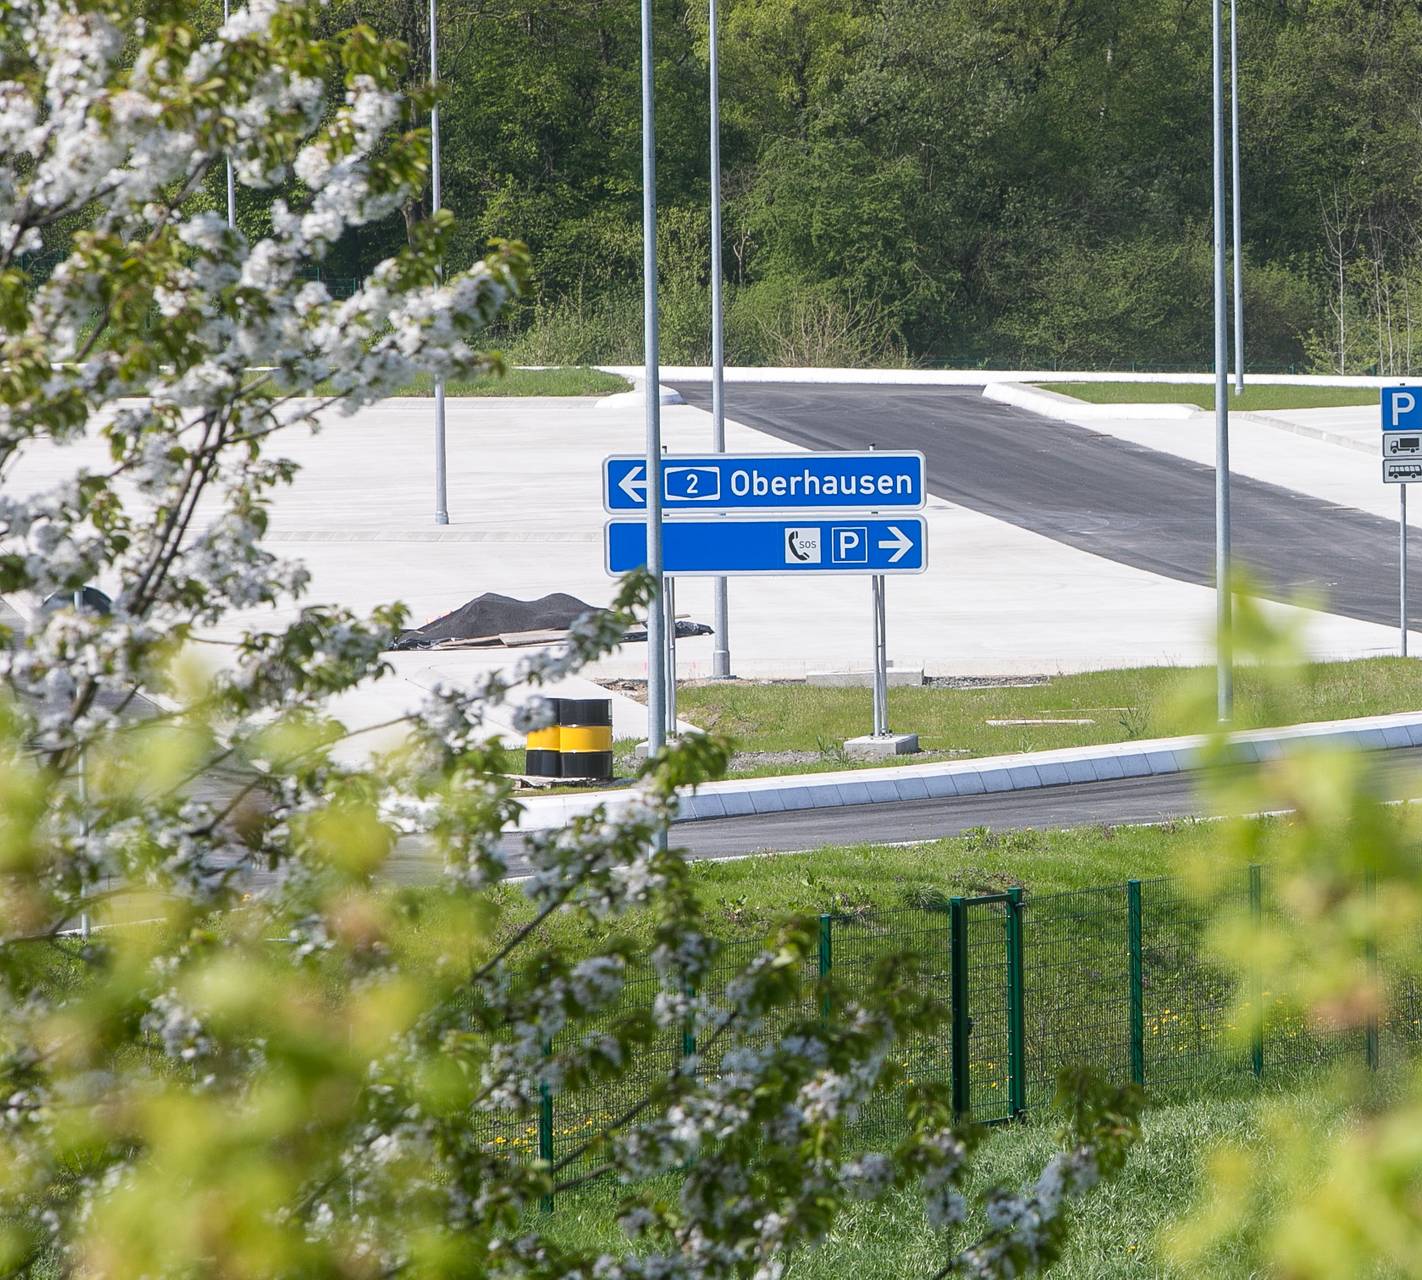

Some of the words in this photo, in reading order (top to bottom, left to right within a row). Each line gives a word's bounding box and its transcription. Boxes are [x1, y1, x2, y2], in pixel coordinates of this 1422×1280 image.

[1392, 392, 1416, 426] P
[686, 474, 698, 495] 2
[730, 469, 912, 497] Oberhausen
[799, 540, 817, 549] SOS
[840, 531, 860, 559] P
